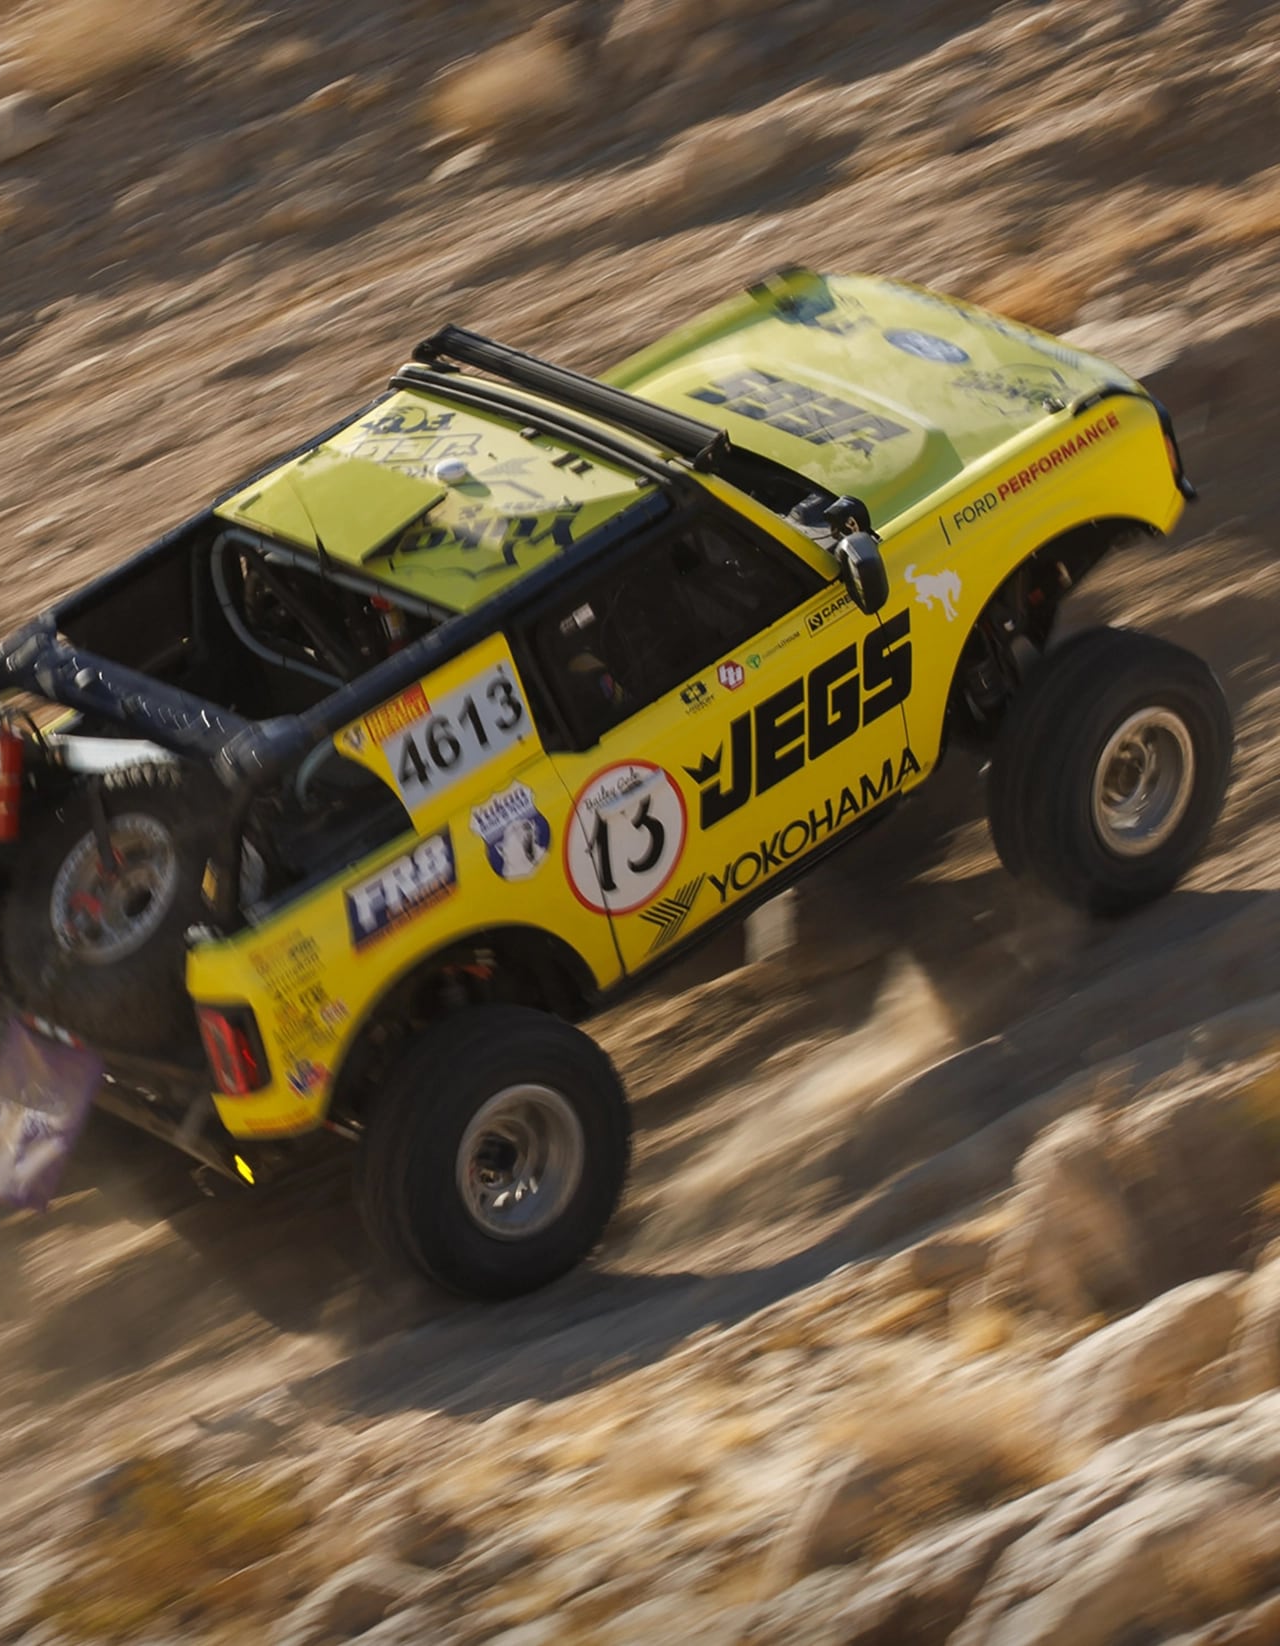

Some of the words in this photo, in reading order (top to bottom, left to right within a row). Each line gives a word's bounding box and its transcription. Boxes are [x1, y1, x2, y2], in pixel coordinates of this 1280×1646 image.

[953, 492, 998, 530] FORD
[997, 411, 1120, 501] PERFORMANCE
[398, 676, 522, 785] 4613
[699, 606, 912, 831] JEGS
[590, 794, 665, 891] 13
[708, 746, 922, 903] YOKOHAMA
